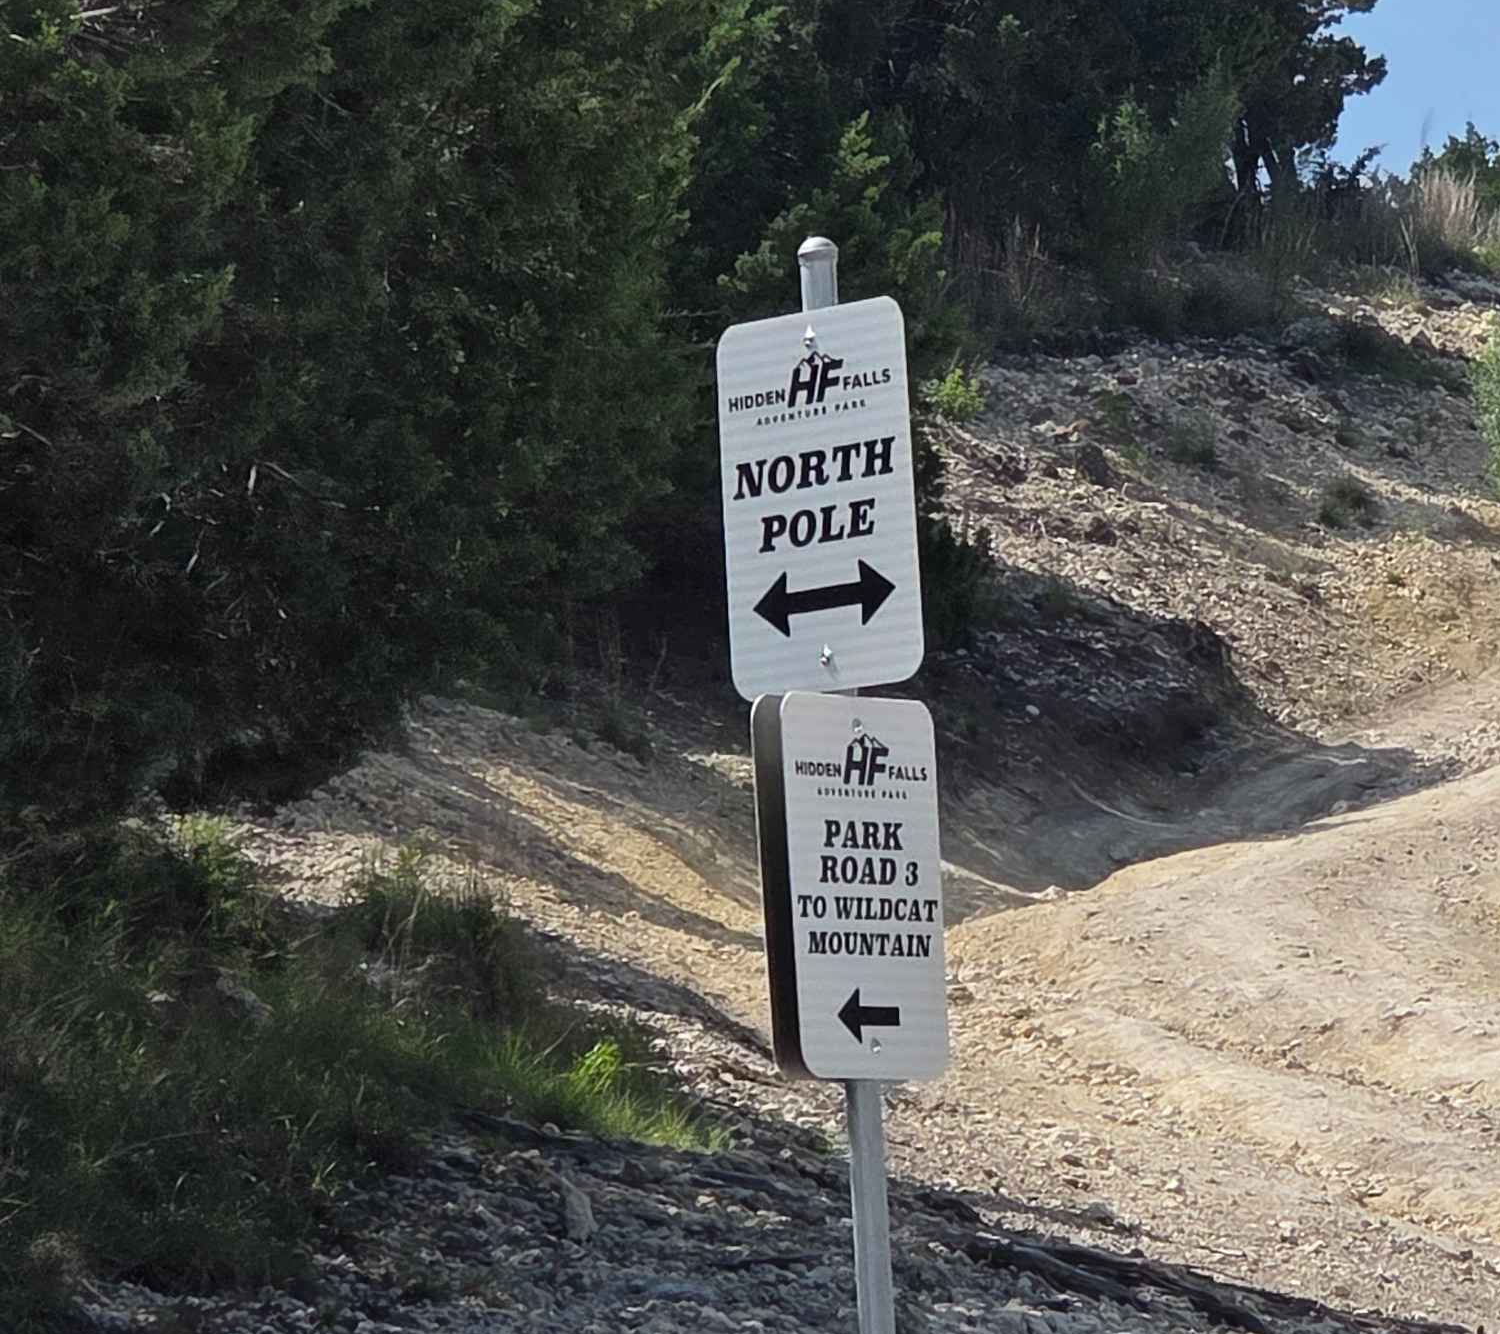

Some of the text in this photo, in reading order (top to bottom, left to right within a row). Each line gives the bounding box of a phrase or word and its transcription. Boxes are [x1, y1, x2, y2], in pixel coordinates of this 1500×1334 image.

[728, 351, 892, 413] HIDDEN HF FALLS
[757, 399, 866, 426] ADVENTURE PARK
[733, 436, 896, 501] NORTH
[759, 498, 875, 553] POLE
[795, 733, 928, 786] HIDDEN HF FALLS
[823, 819, 903, 850] PARK
[819, 855, 919, 886] ROAD 3
[797, 895, 938, 922] TO WILDCAT
[808, 931, 932, 957] MOUNTAIN
